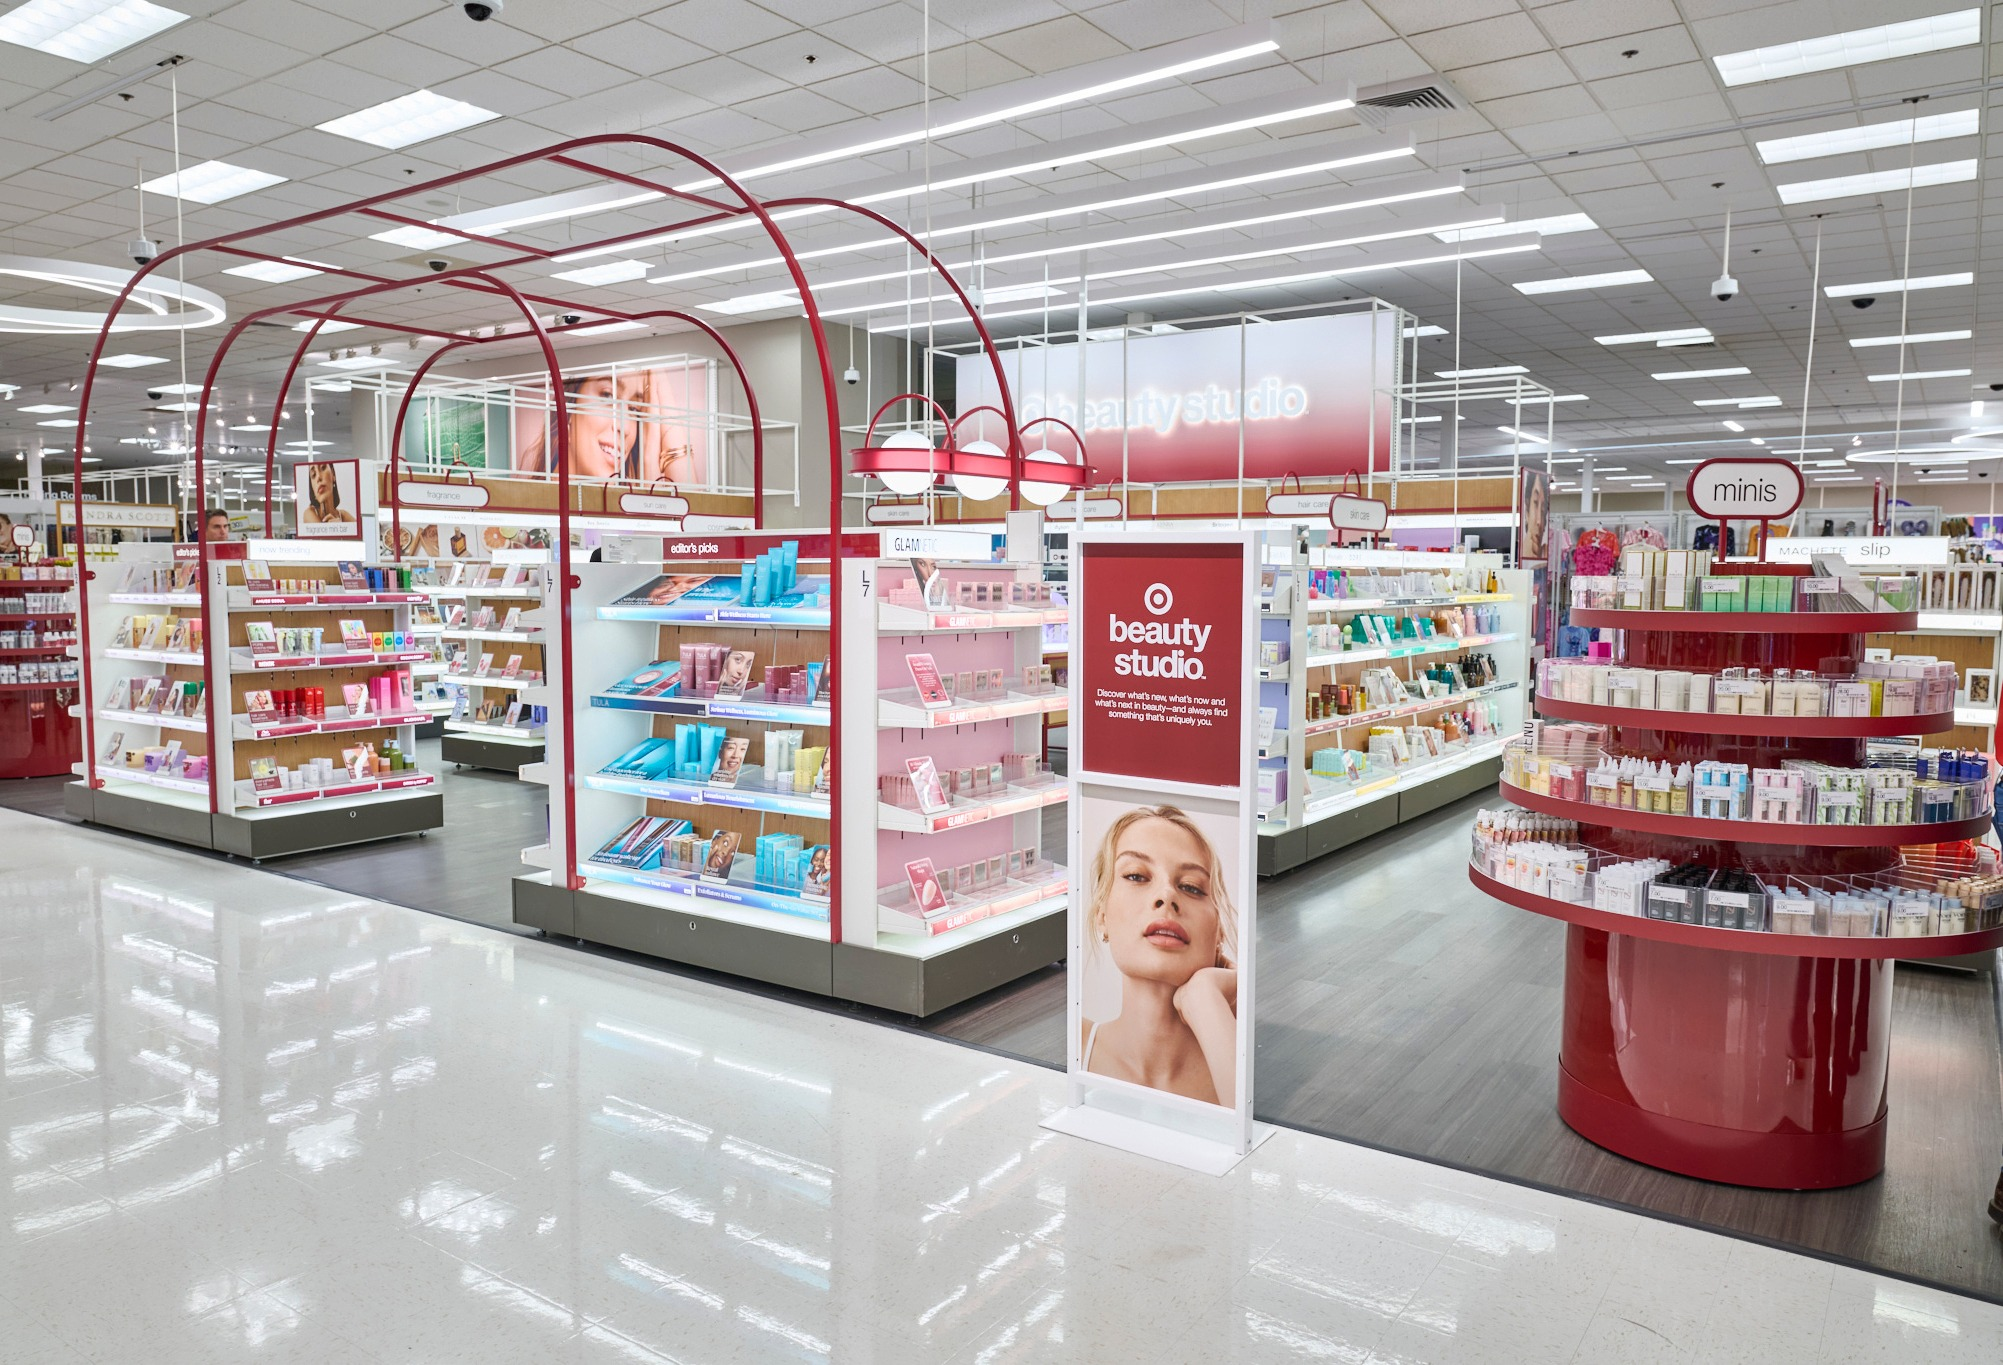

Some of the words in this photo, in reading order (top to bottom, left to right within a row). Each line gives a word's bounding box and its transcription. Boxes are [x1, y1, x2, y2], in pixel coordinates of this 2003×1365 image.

[1052, 390, 1176, 434] beauty
[60, 491, 98, 500] Roms
[427, 490, 461, 501] fragrance
[1713, 478, 1777, 502] minis
[1298, 500, 1311, 508] hair
[67, 510, 123, 520] KNDRA
[128, 511, 170, 521] SCOTT
[1350, 509, 1359, 519] skin
[1359, 512, 1370, 521] care
[671, 543, 698, 554] editor's
[699, 543, 719, 556] picks
[1860, 543, 1891, 559] slip
[1109, 613, 1212, 653] beauty
[592, 698, 609, 707] TULA
[1097, 688, 1127, 699] Discover
[1128, 691, 1150, 701] what's
[1151, 693, 1168, 703] new,
[1169, 694, 1192, 704] what's
[1193, 697, 1210, 705] now
[1210, 697, 1226, 706] and
[1094, 699, 1117, 708] what's
[1117, 701, 1133, 709] next
[1133, 701, 1141, 710] in
[1187, 706, 1213, 716] always
[1213, 707, 1228, 717] find
[1108, 710, 1145, 722] something
[1145, 712, 1165, 722] that's
[1165, 714, 1196, 726] uniquely
[1196, 718, 1213, 727] you.
